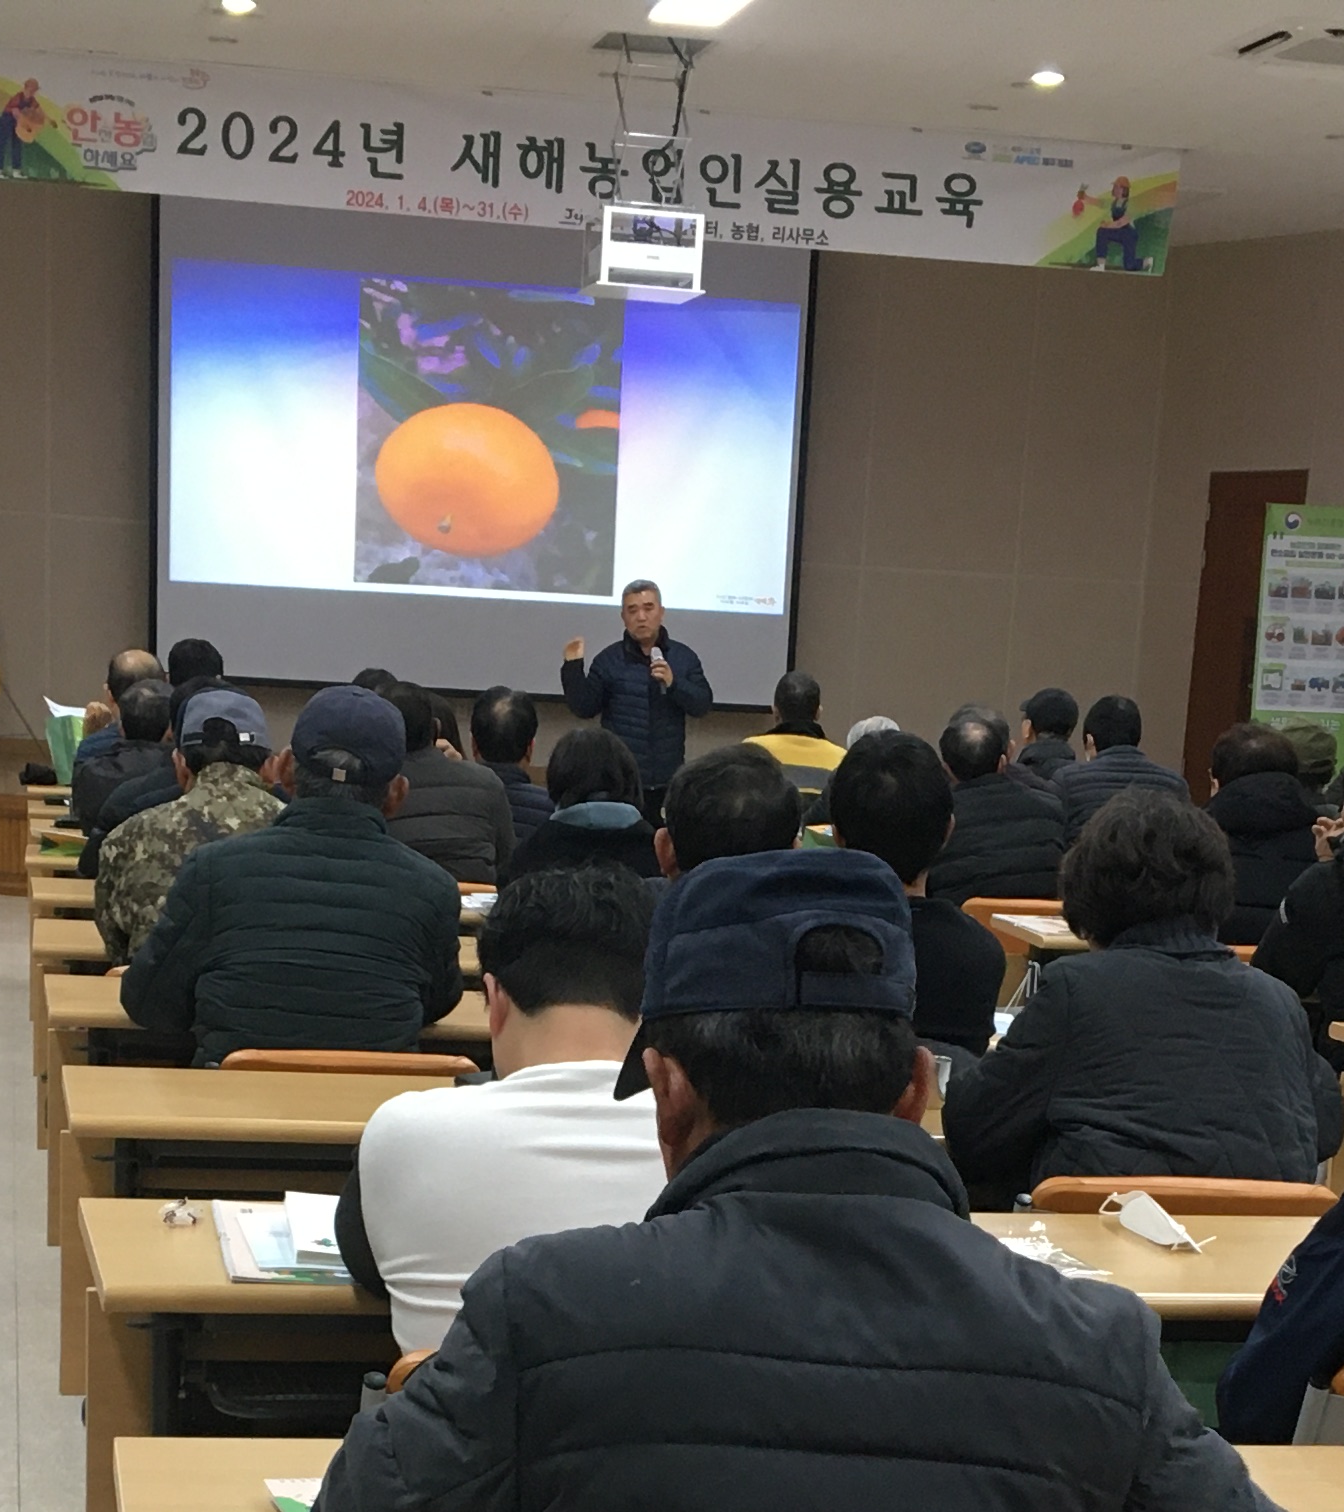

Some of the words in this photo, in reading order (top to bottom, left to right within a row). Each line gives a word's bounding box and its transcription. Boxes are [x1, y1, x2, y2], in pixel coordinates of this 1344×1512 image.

[177, 106, 405, 181] 2024년
[346, 189, 389, 211] 2024.
[731, 221, 764, 242] 농협,
[772, 226, 829, 246] 리사무소
